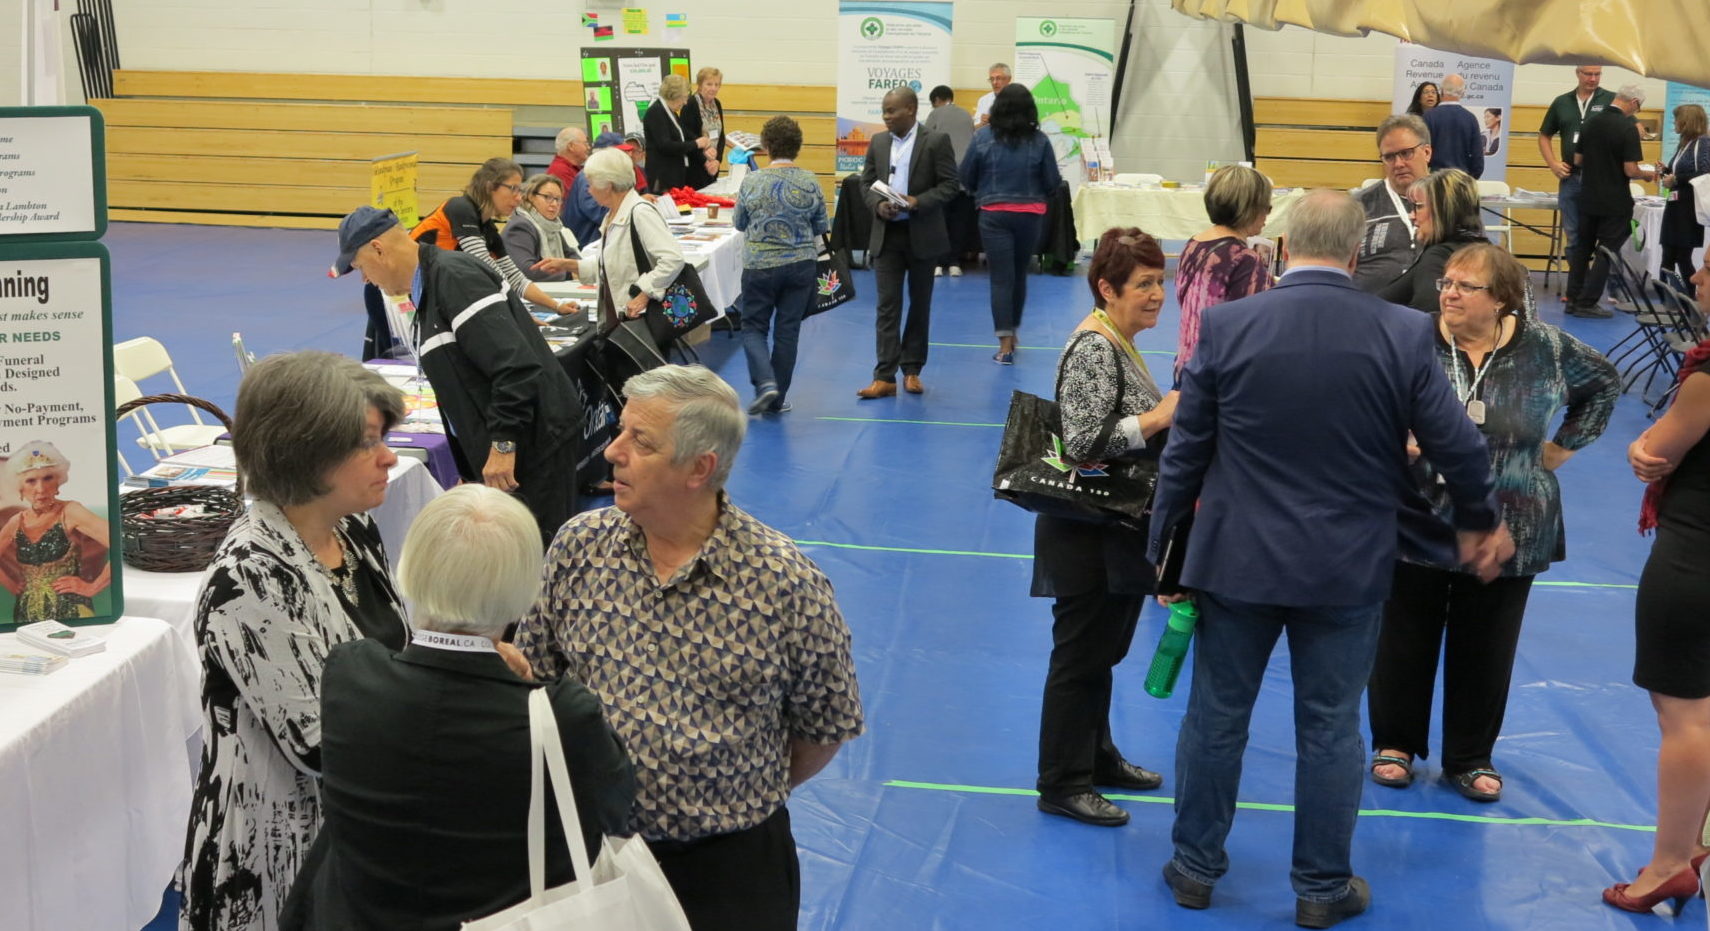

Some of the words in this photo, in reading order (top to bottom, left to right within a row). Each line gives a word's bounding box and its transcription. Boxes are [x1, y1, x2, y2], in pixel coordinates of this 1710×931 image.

[1410, 59, 1444, 68] Canada
[1457, 61, 1491, 70] Agence
[867, 67, 922, 78] VOYAGES
[1406, 70, 1444, 78] Revenue
[1470, 73, 1500, 81] revenu
[1470, 82, 1504, 91] Canada
[5, 201, 47, 210] Lambton
[30, 211, 60, 220] Award
[11, 310, 48, 321] makes
[51, 311, 84, 320] sense
[12, 331, 61, 342] NEEDS
[5, 367, 60, 379] Designed
[5, 402, 84, 416] No-Payment,
[37, 414, 96, 427] Programs
[1031, 476, 1082, 492] CANADA
[1090, 488, 1110, 496] 150
